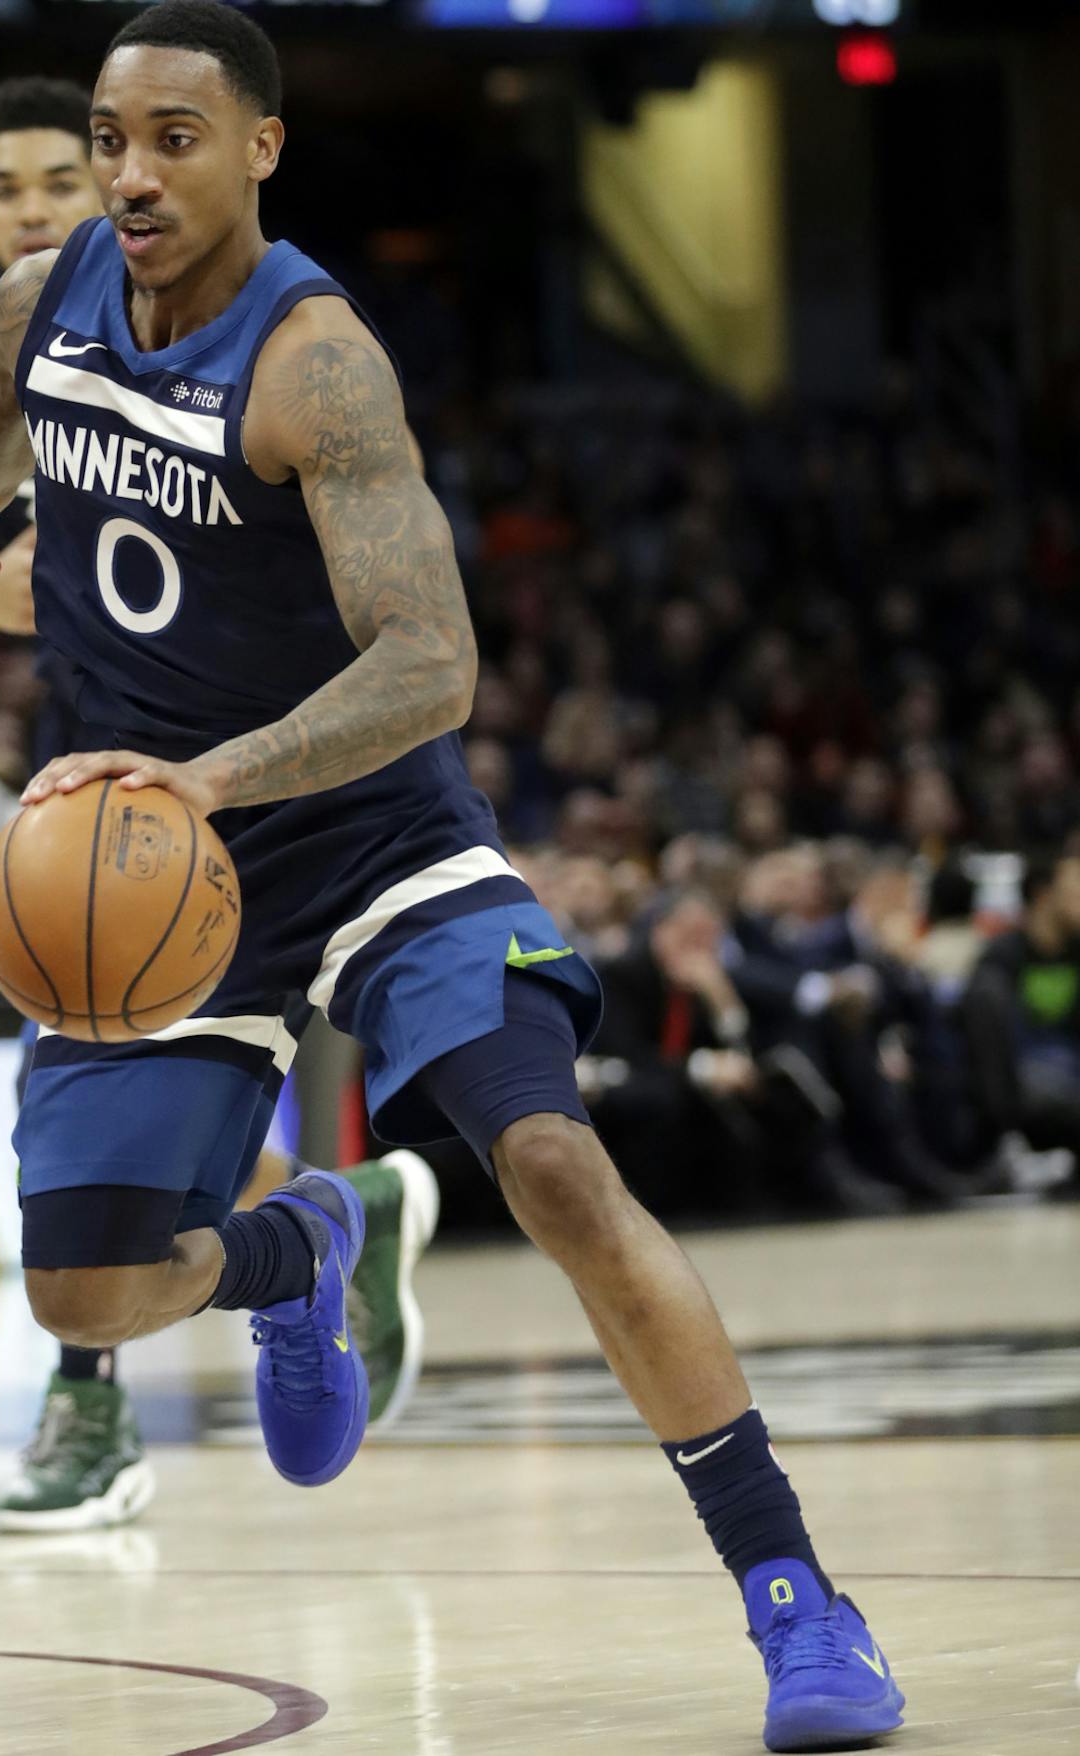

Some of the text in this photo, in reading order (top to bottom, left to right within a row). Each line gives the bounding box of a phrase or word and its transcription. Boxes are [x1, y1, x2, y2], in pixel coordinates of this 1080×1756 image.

[191, 386, 224, 409] fitbit
[24, 410, 244, 526] MINNESOTA
[96, 517, 181, 634] 0
